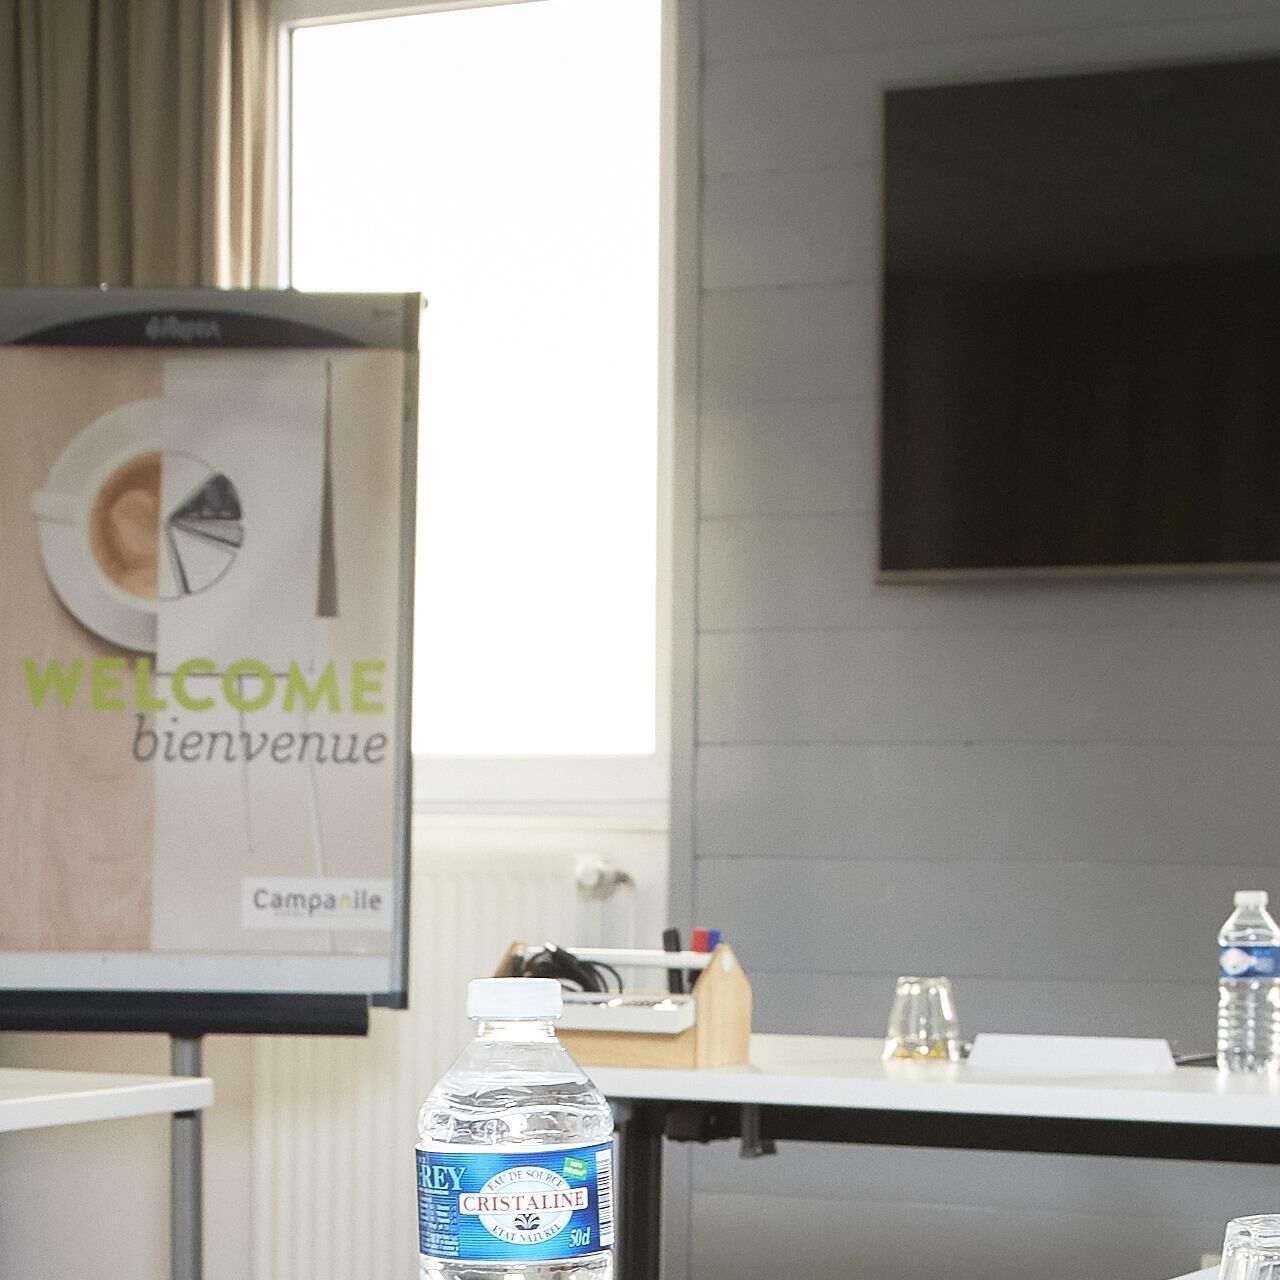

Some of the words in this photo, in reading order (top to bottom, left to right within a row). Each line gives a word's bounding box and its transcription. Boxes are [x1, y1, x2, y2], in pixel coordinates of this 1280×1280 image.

[23, 656, 386, 713] WELCOME
[132, 713, 387, 765] bienvenue
[253, 888, 382, 917] Campanile
[487, 1173, 506, 1191] EAU
[509, 1170, 523, 1181] DE
[527, 1170, 562, 1188] SOURCE
[463, 1191, 584, 1212] CRISTALINE
[520, 1224, 561, 1242] NATUREL
